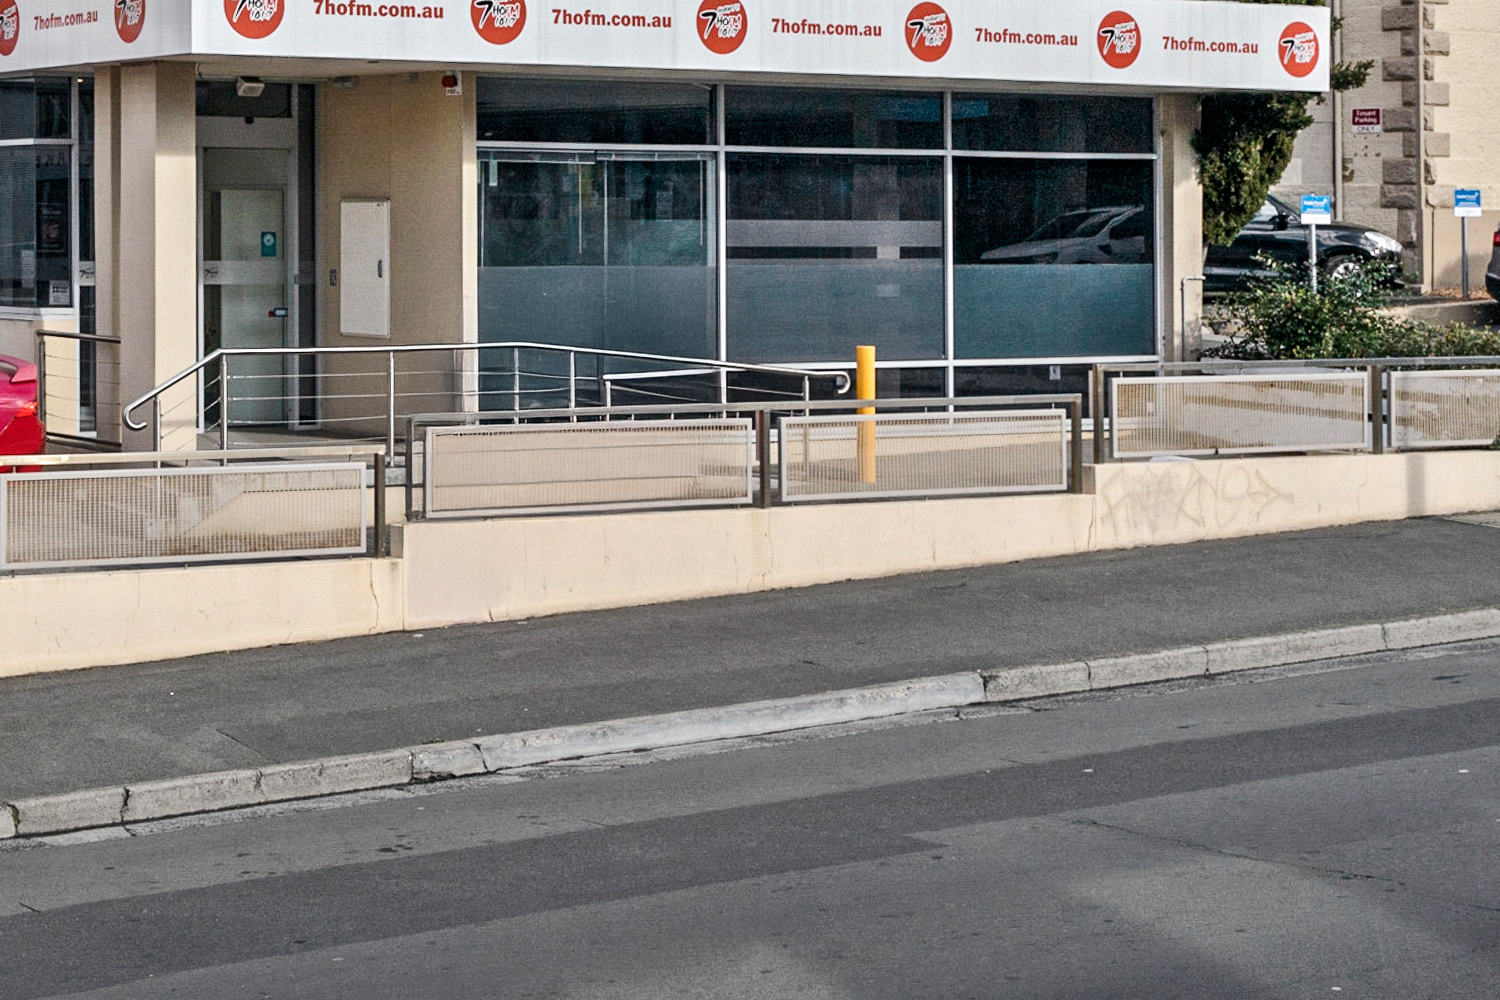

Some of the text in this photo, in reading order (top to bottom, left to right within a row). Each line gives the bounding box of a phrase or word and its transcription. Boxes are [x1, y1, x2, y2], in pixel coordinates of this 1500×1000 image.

[314, 0, 443, 18] 7hofm.com.au
[34, 11, 98, 30] 7hofm.com.au
[553, 9, 671, 27] 7hofm.com.au
[773, 19, 881, 36] 7hofm.com.au
[976, 28, 1077, 45] 7hofm.com.au
[1164, 37, 1258, 53] 7hofm.com.au
